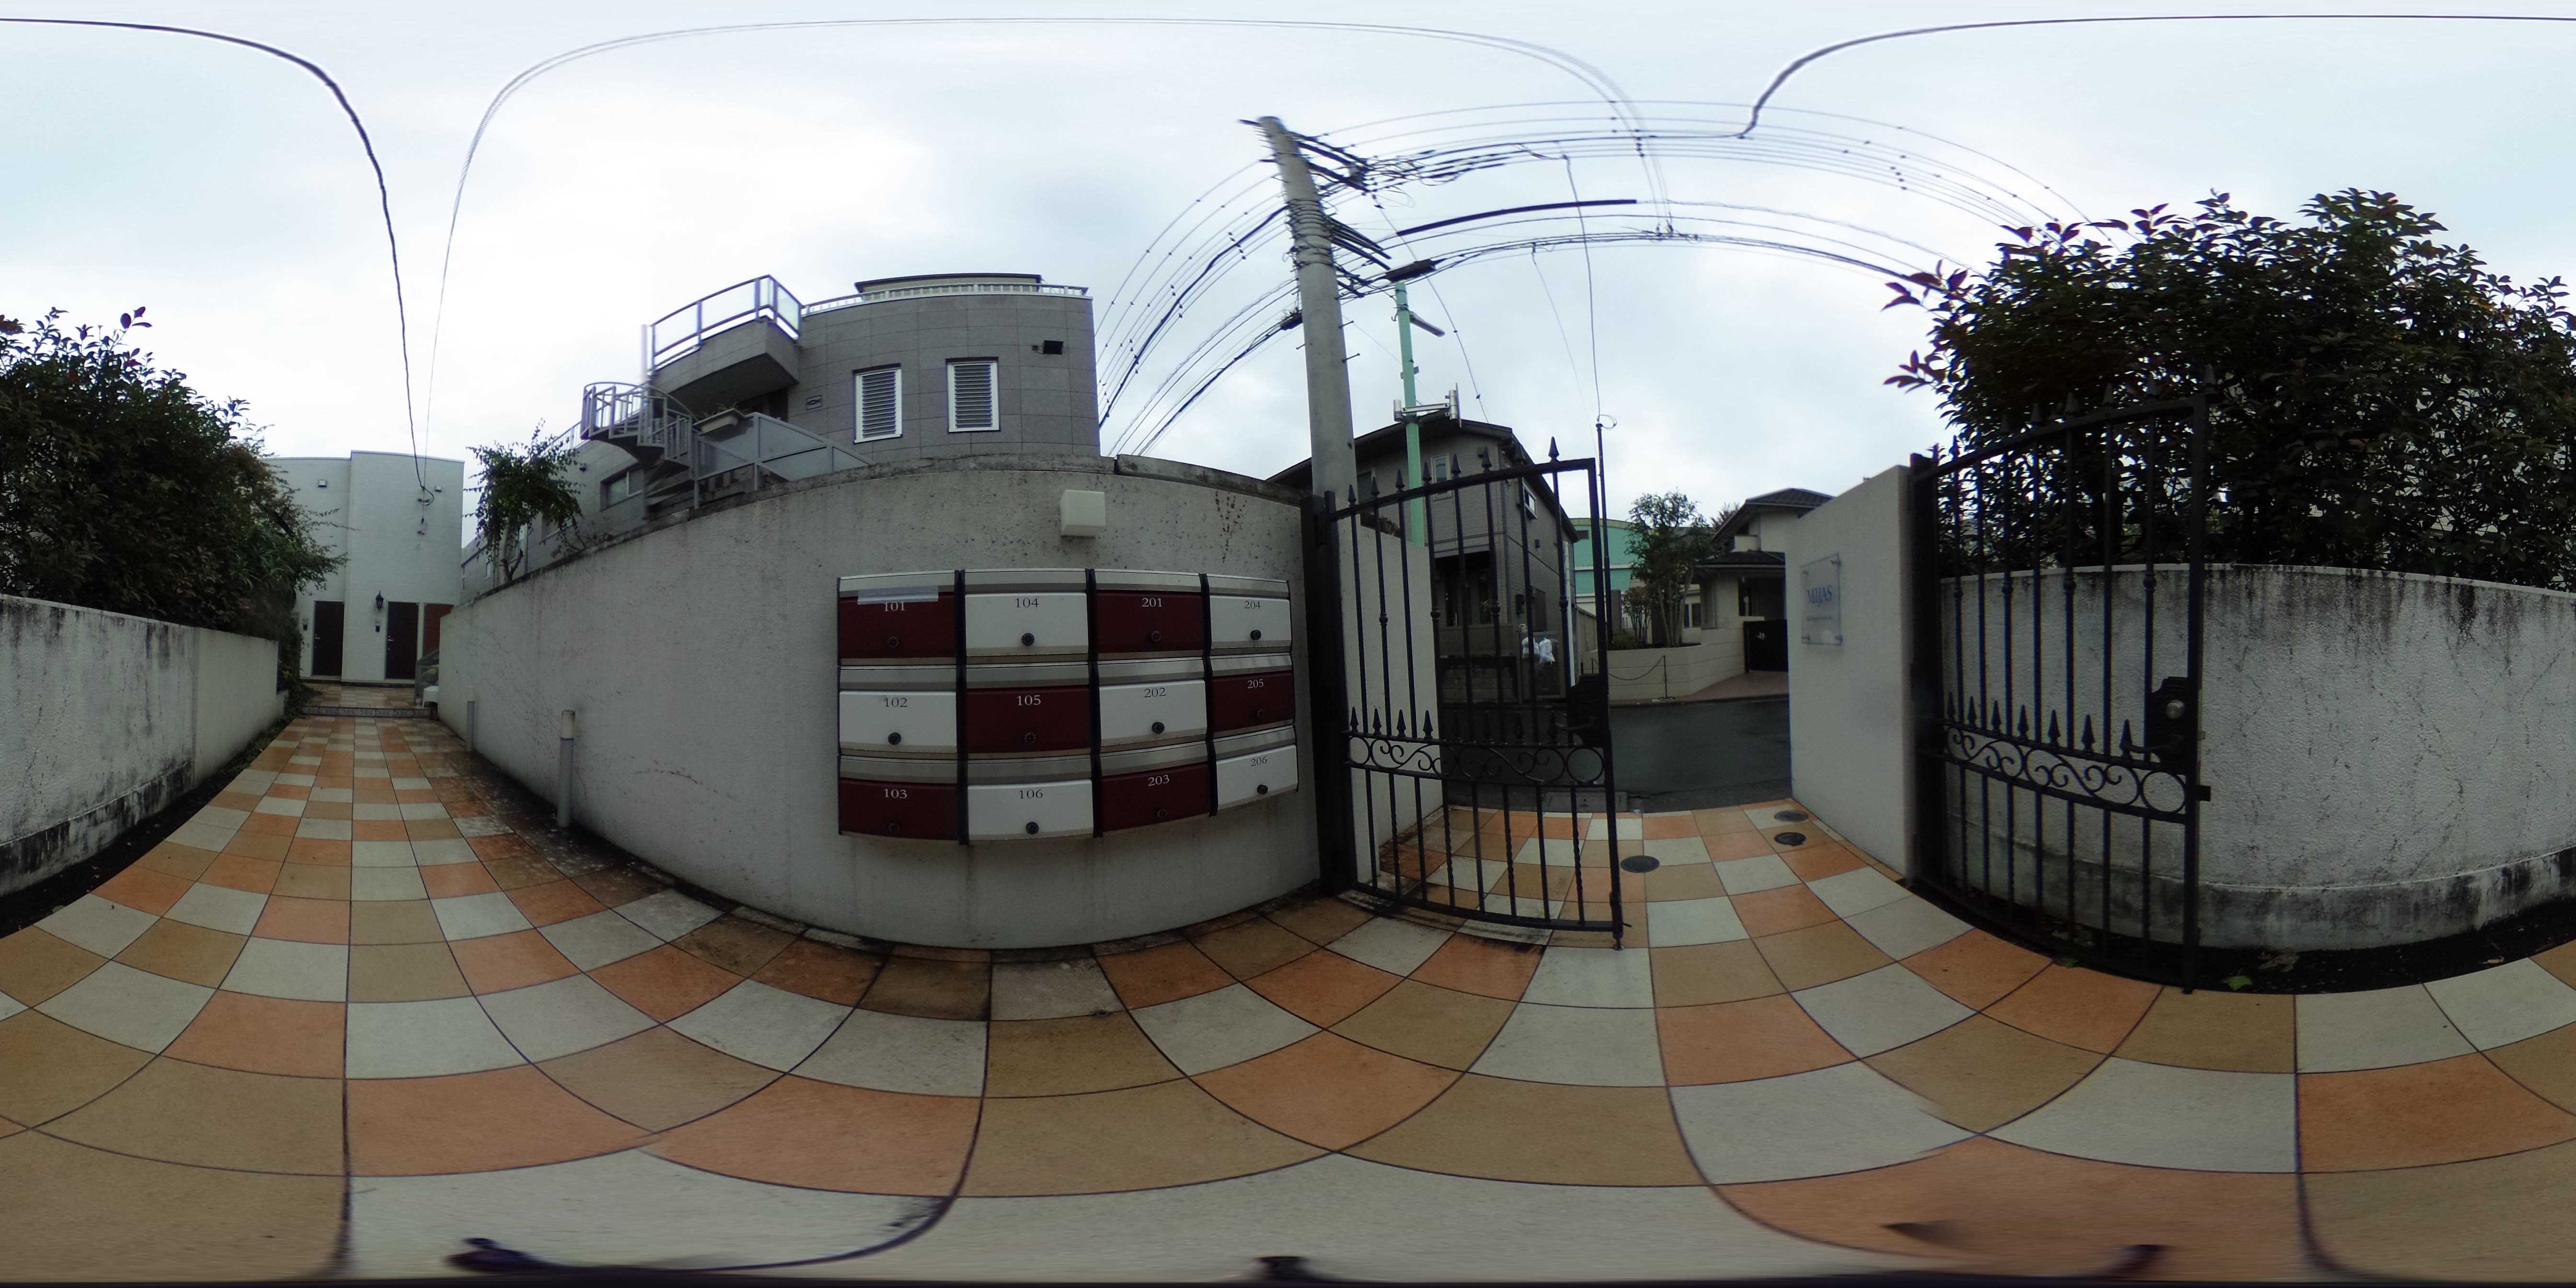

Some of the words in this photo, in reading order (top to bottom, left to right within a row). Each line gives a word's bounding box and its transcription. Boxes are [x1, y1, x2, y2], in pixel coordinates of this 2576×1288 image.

[884, 602, 905, 611] 101
[1015, 598, 1039, 608] 104
[1142, 598, 1163, 607] 201
[1244, 600, 1261, 610] 204
[1247, 678, 1264, 689] 205
[1144, 687, 1166, 698] 202
[884, 698, 908, 708] 102
[1016, 695, 1041, 706] 105
[1250, 755, 1267, 767] 206
[1148, 774, 1170, 786] 203
[884, 788, 907, 799] 103
[1019, 789, 1043, 799] 106
